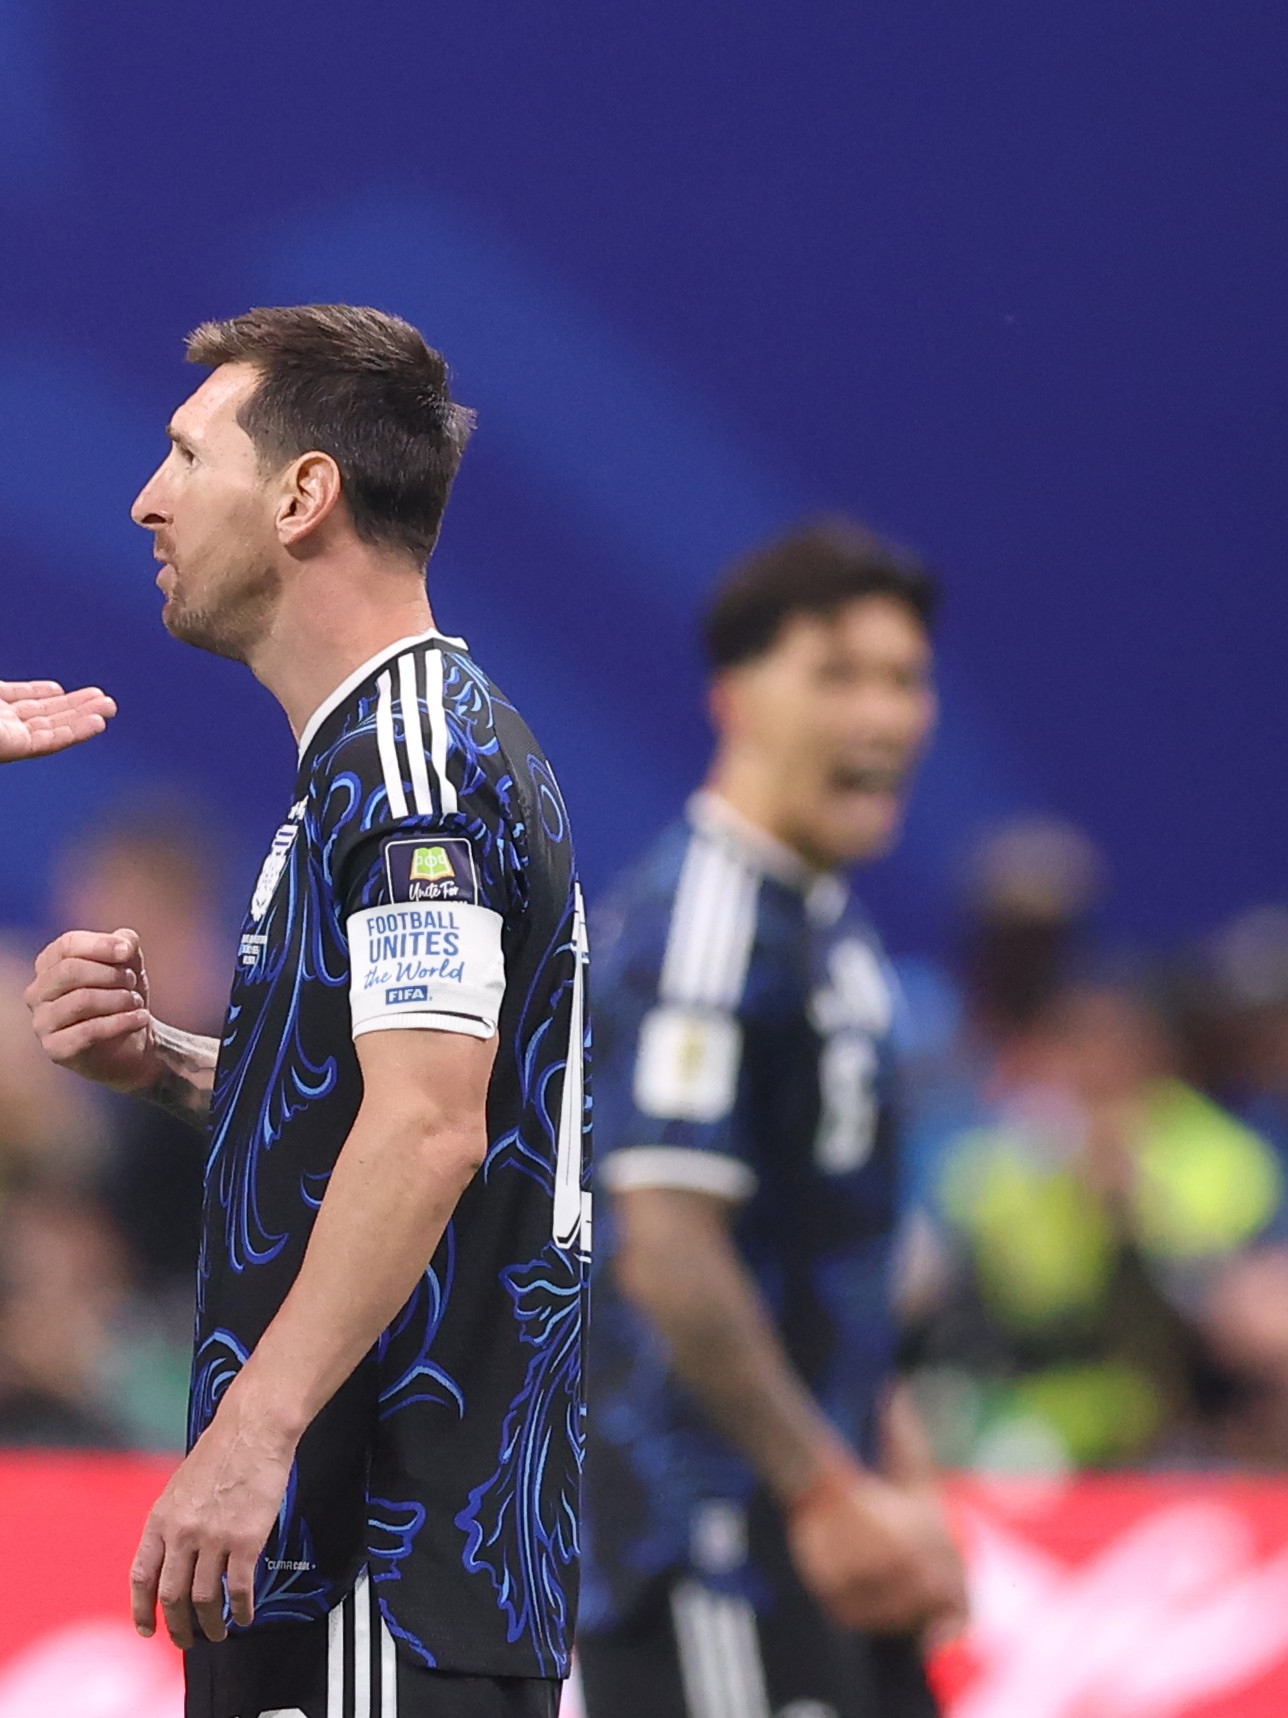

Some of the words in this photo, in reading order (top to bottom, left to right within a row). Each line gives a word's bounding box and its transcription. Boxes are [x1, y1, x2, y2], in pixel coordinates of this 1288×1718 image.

[409, 882, 440, 900] Unite
[440, 881, 459, 899] For
[367, 911, 460, 936] FOOTBALL
[369, 931, 460, 963] UNITES
[364, 966, 393, 990] the
[396, 958, 465, 983] World
[388, 988, 425, 1003] FIFA
